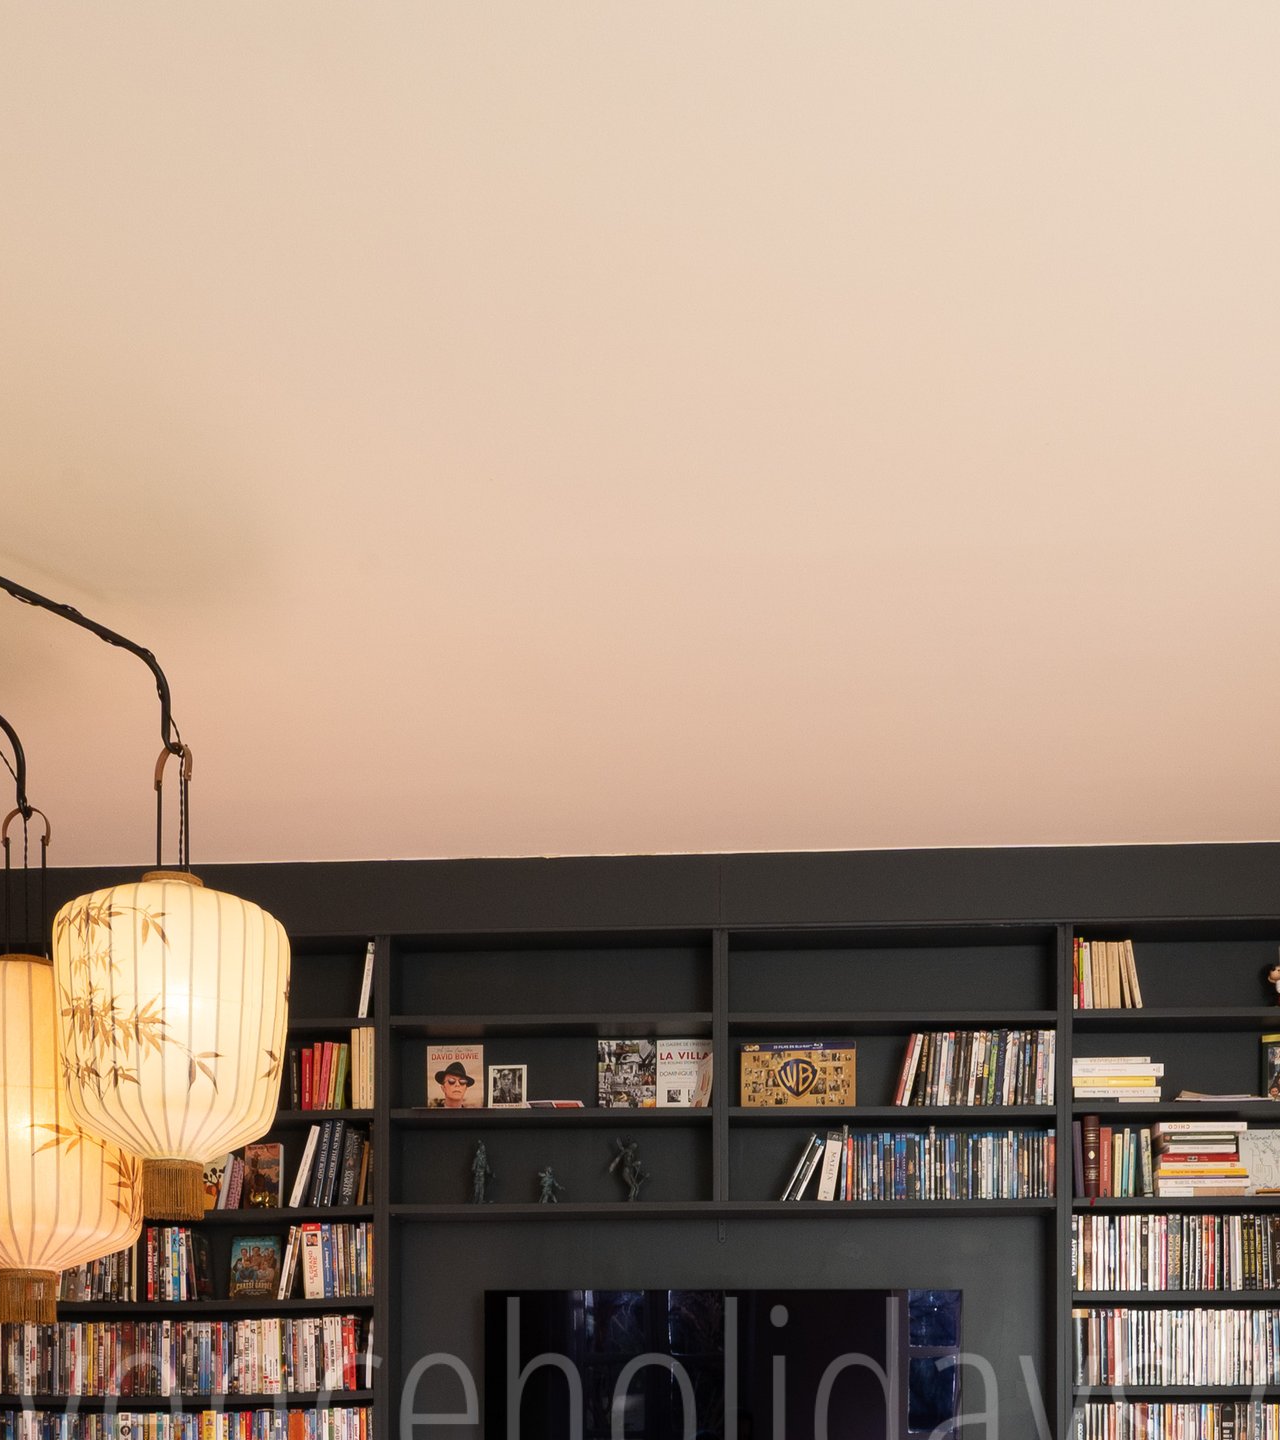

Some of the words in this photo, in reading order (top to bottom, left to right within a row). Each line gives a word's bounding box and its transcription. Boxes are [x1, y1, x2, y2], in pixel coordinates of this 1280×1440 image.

[431, 1053, 453, 1062] DAVID
[455, 1052, 480, 1061] BOWIE
[660, 1051, 674, 1061] LA
[780, 1062, 813, 1092] WB
[309, 1274, 315, 1284] LE
